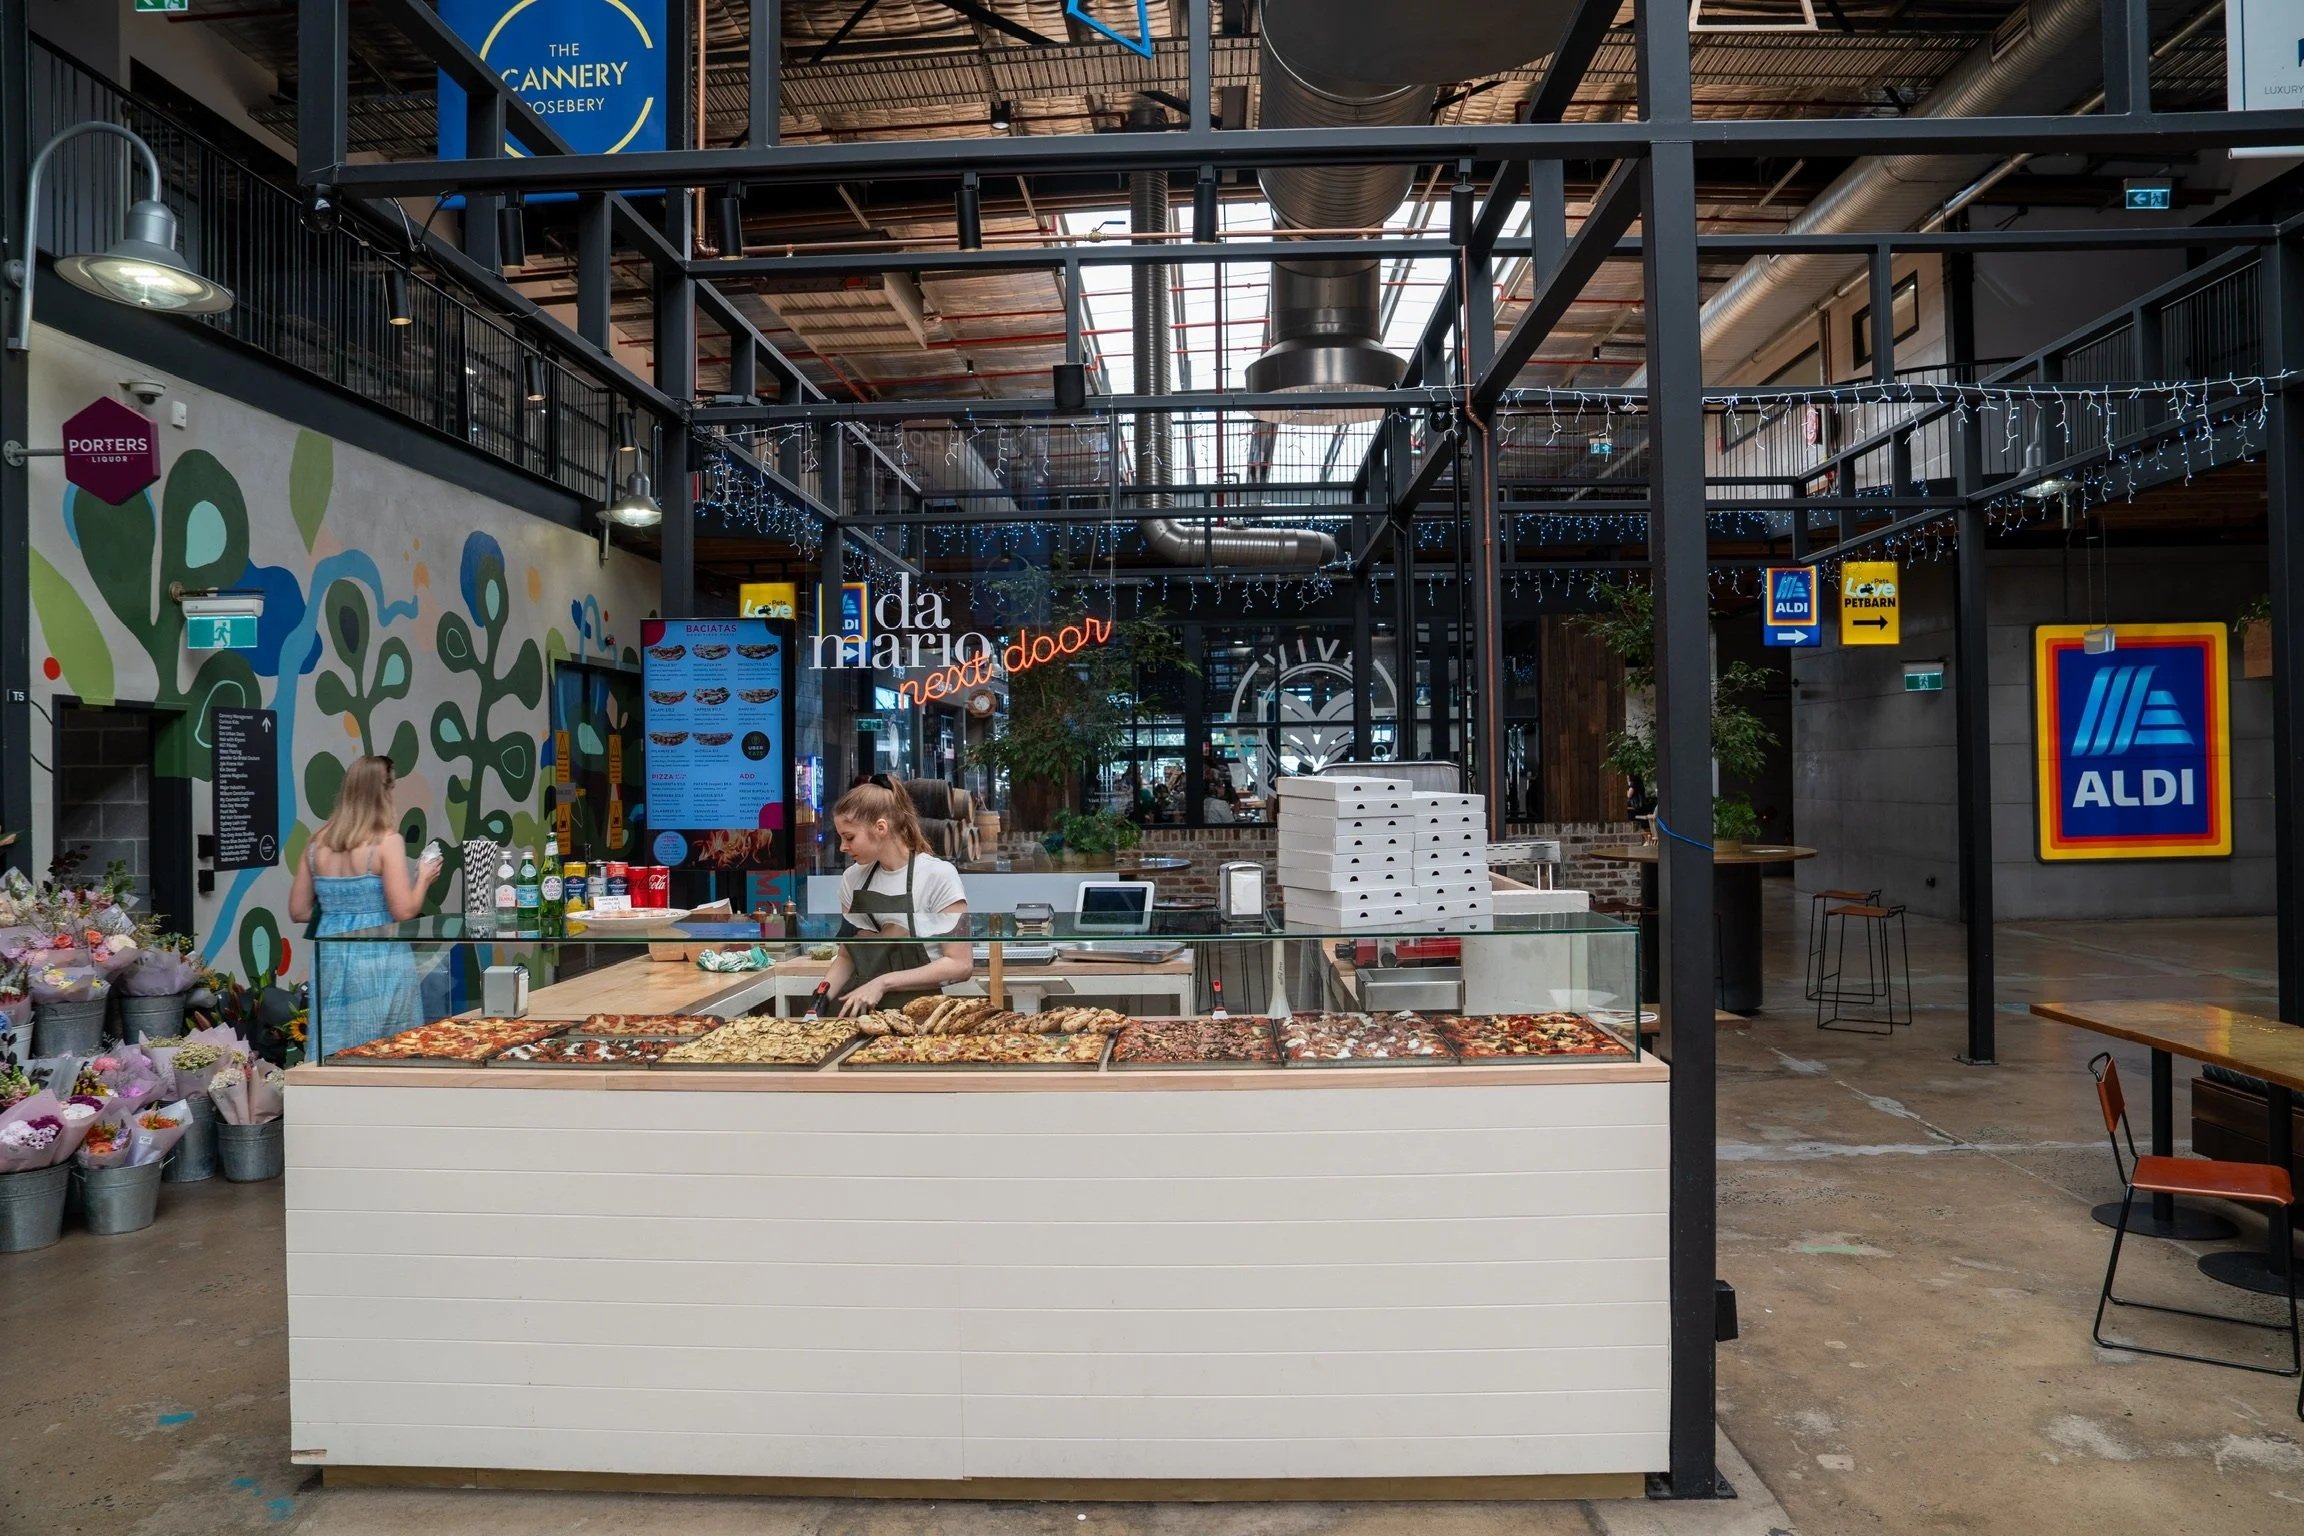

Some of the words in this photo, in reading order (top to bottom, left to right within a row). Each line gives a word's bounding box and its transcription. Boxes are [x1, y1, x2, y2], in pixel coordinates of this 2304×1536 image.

[549, 43, 580, 57] THE
[501, 61, 628, 92] CANNERY
[526, 97, 605, 115] OSEBERY
[69, 438, 148, 453] PORTERS
[874, 571, 951, 630] da
[1775, 602, 1808, 613] ALDI
[1844, 597, 1896, 608] PETBARN
[686, 624, 737, 633] BACIATAS
[808, 630, 992, 670] mario
[1003, 616, 1112, 674] door
[898, 650, 995, 712] next
[12, 691, 25, 701] T5
[2073, 769, 2194, 808] ALDI
